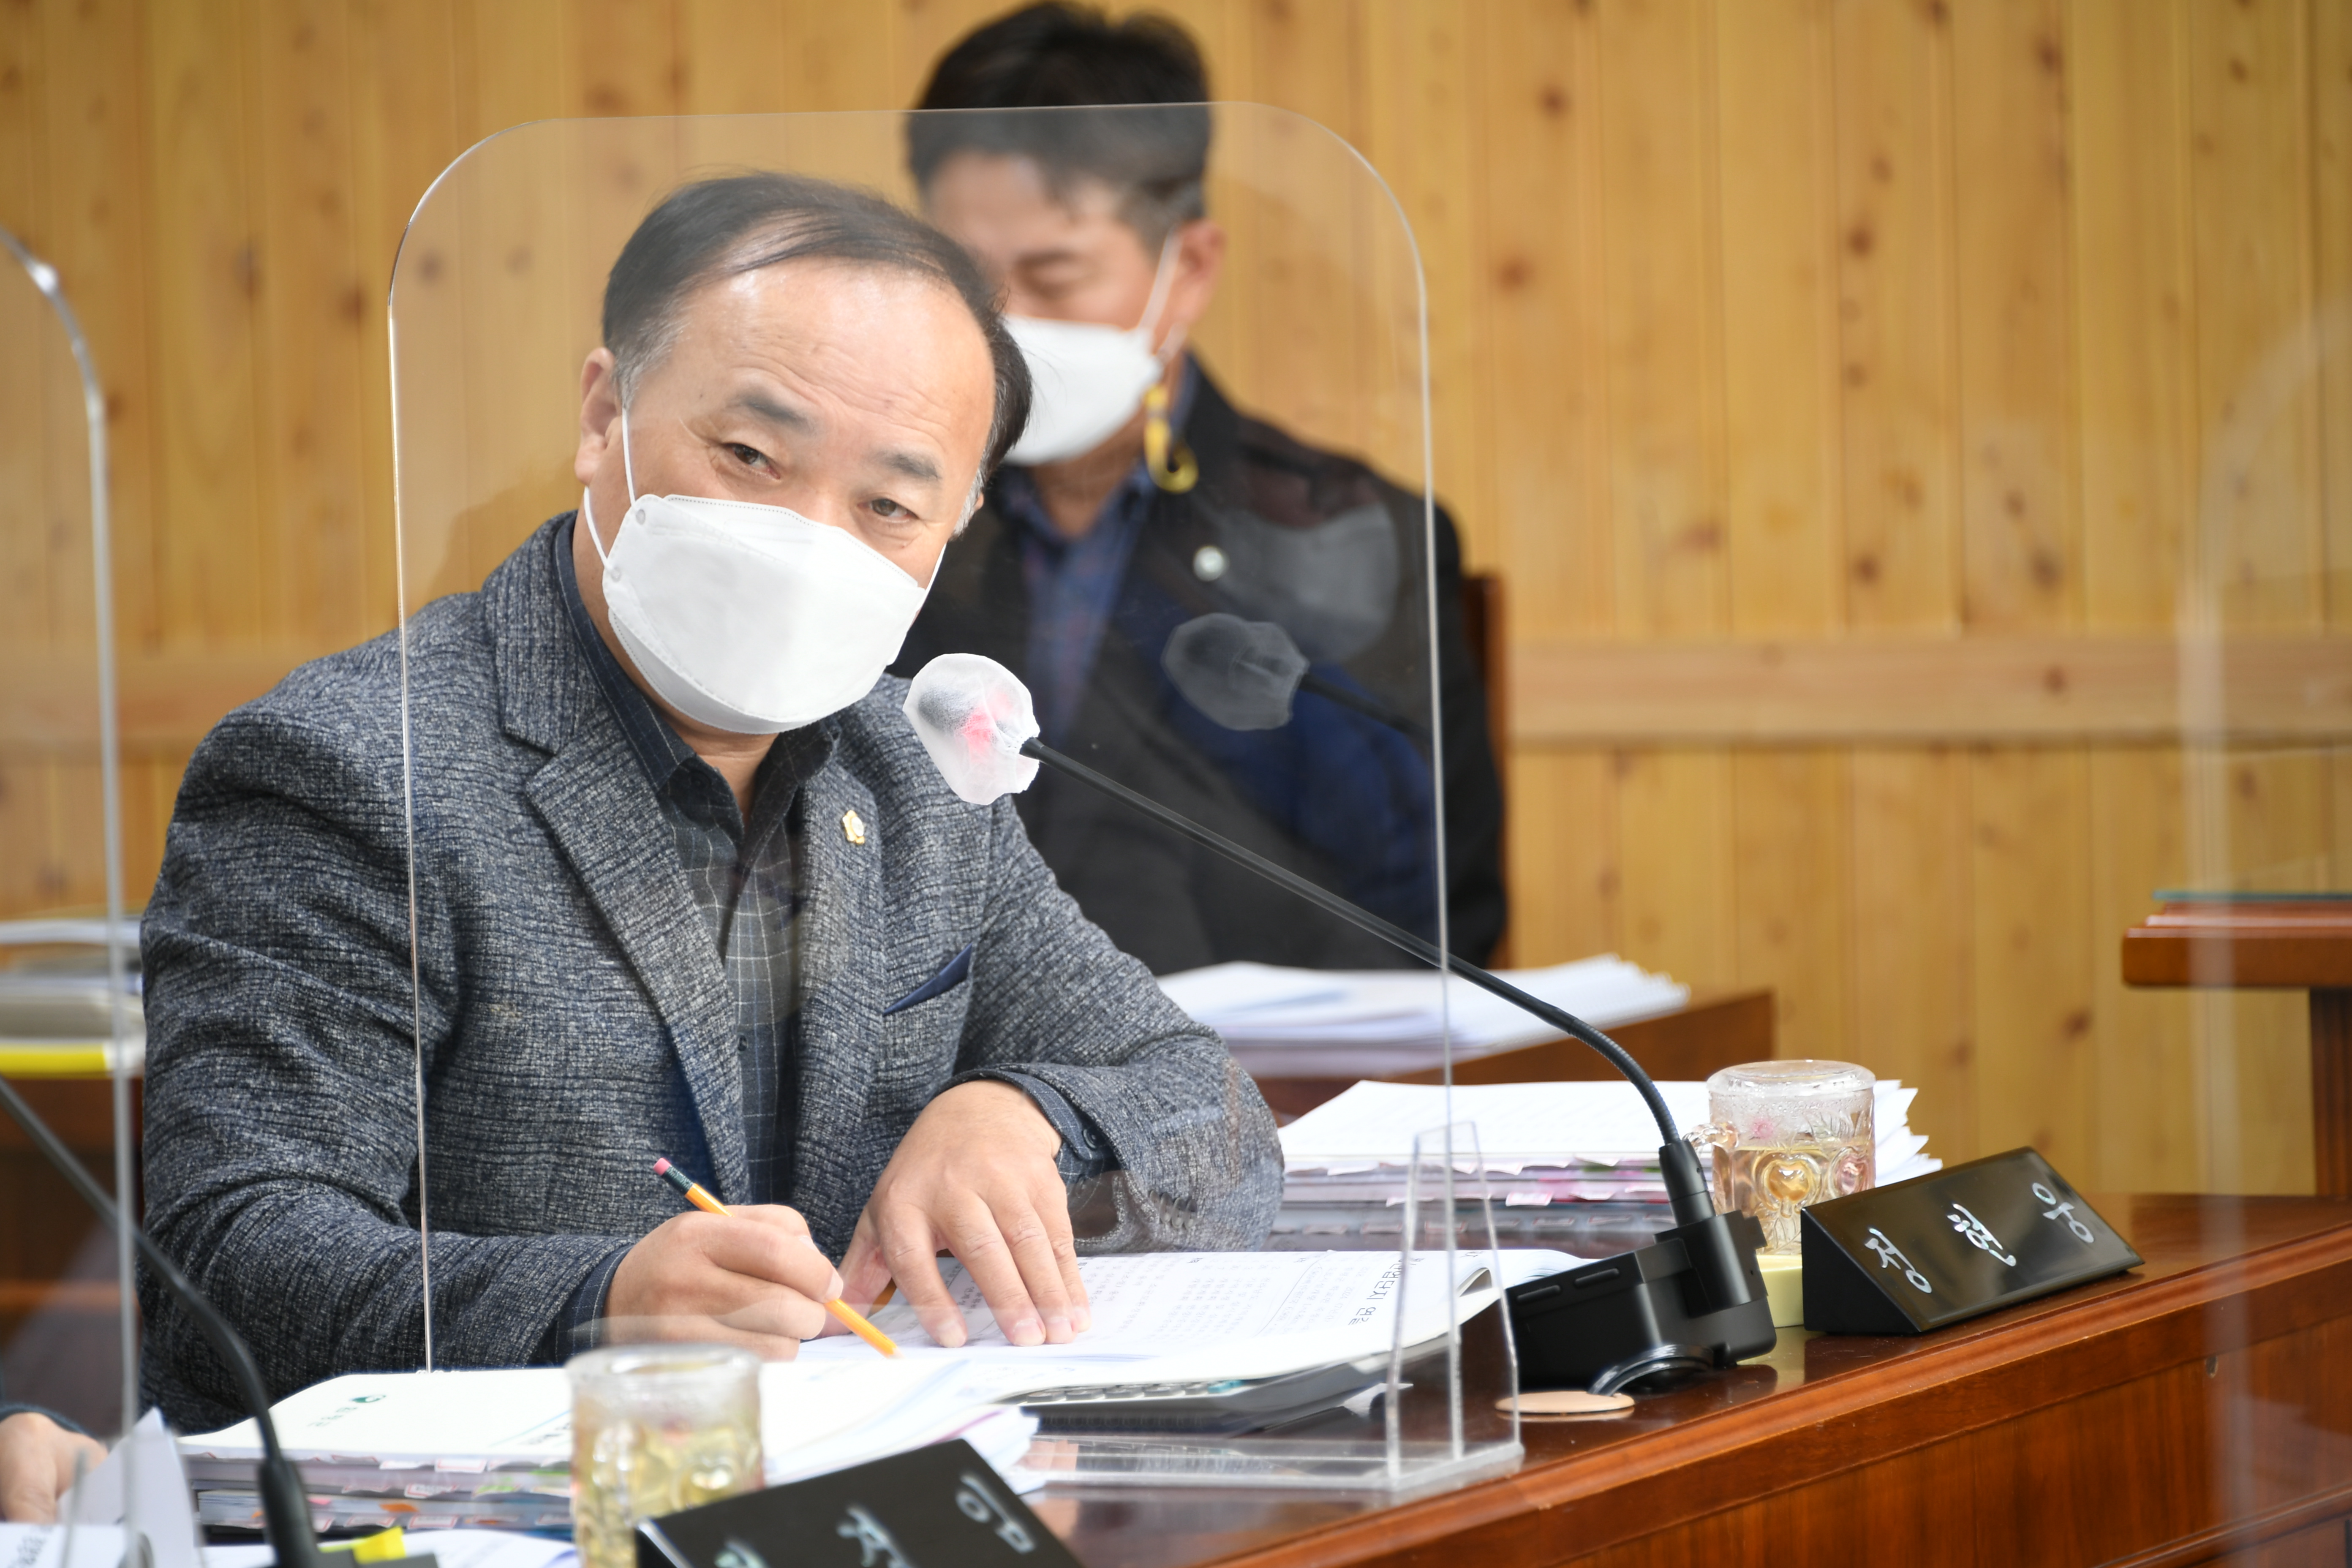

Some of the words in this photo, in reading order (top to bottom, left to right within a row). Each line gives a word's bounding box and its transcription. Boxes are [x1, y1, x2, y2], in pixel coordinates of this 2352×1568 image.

[1865, 1227, 1932, 1293] 정
[1947, 1203, 2017, 1266] 현
[2032, 1183, 2094, 1244] 웅
[956, 1474, 1035, 1553] 임
